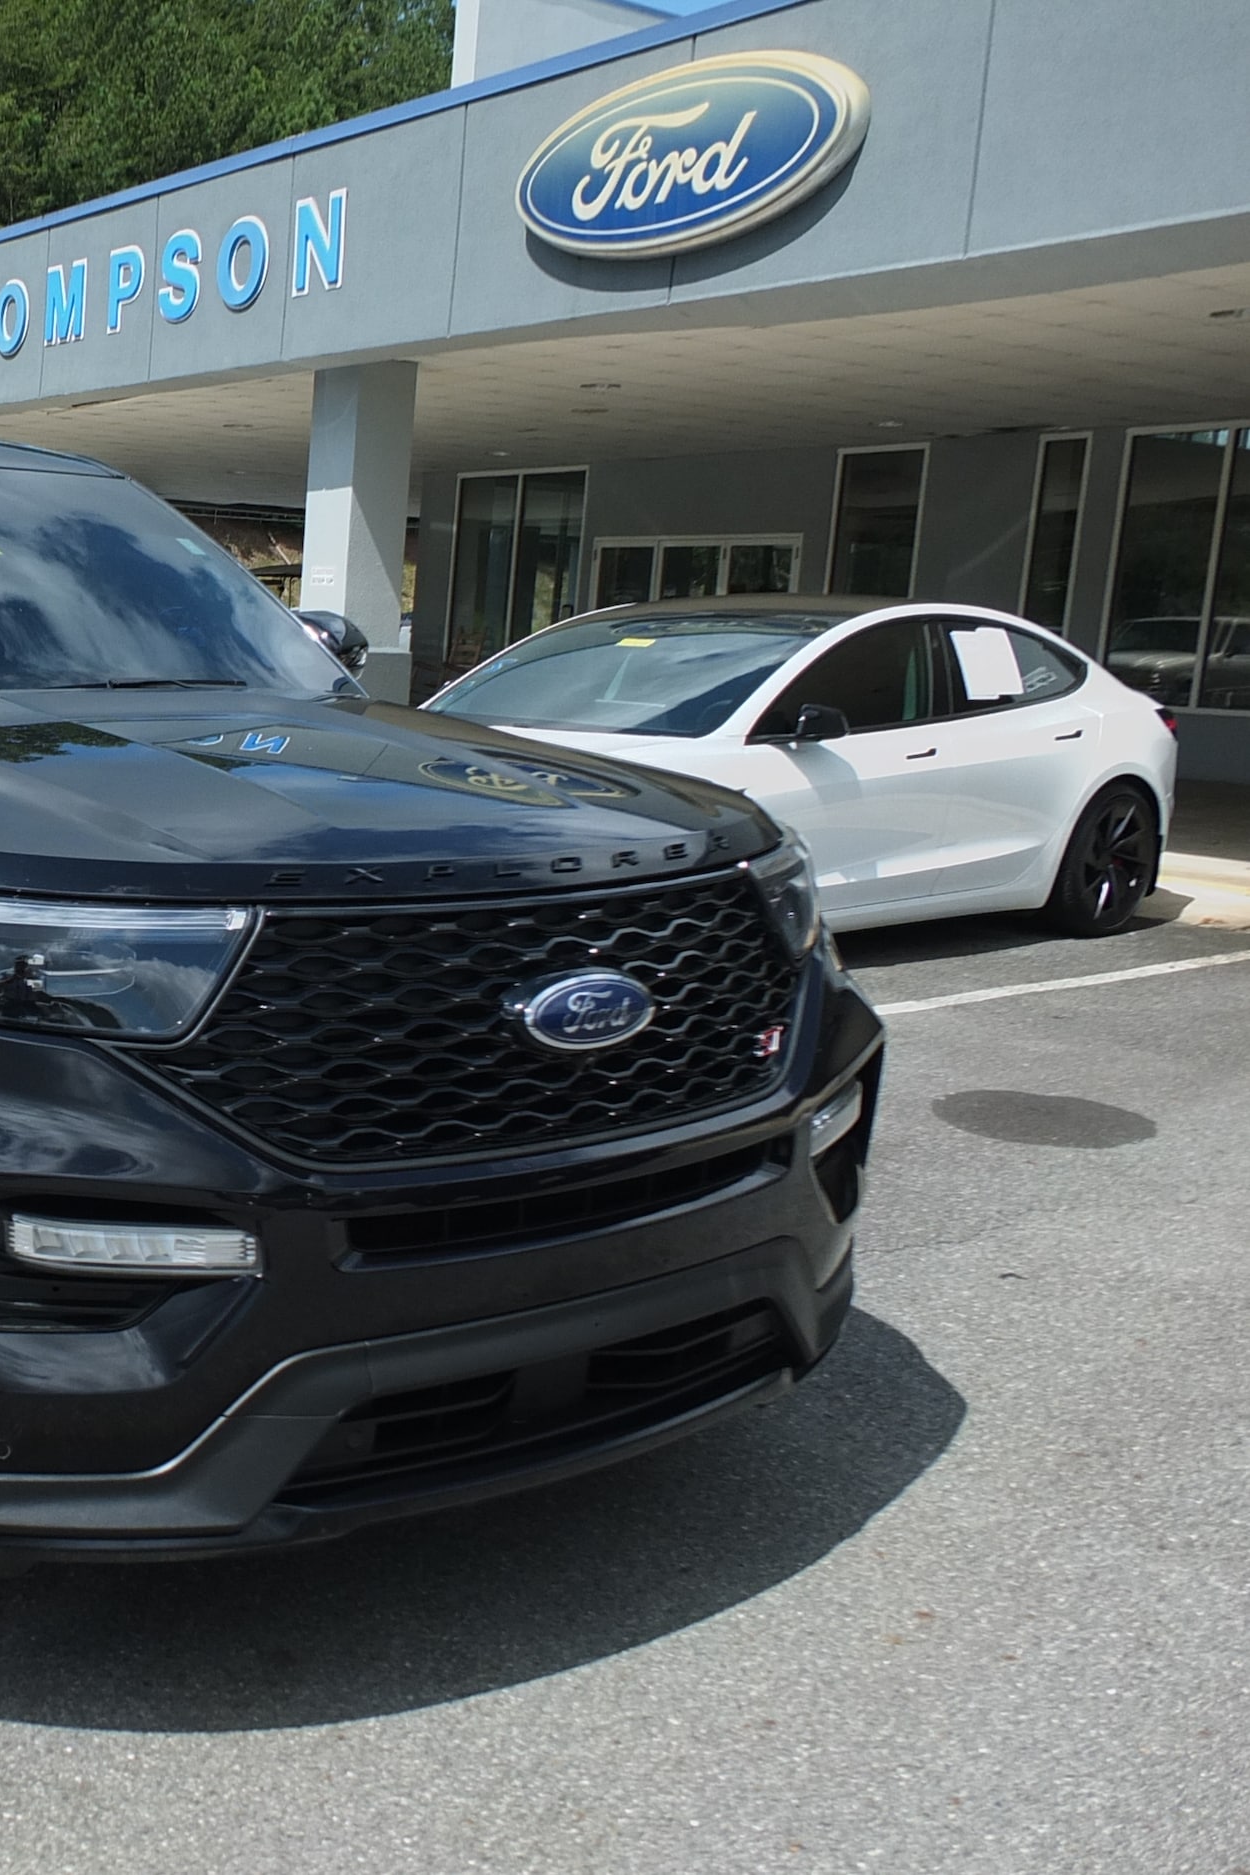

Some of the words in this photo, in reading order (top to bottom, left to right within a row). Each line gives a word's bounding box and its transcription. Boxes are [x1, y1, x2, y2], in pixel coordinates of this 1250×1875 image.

[572, 102, 757, 221] Ford
[265, 833, 729, 886] EXPLORER
[563, 990, 630, 1033] Ford
